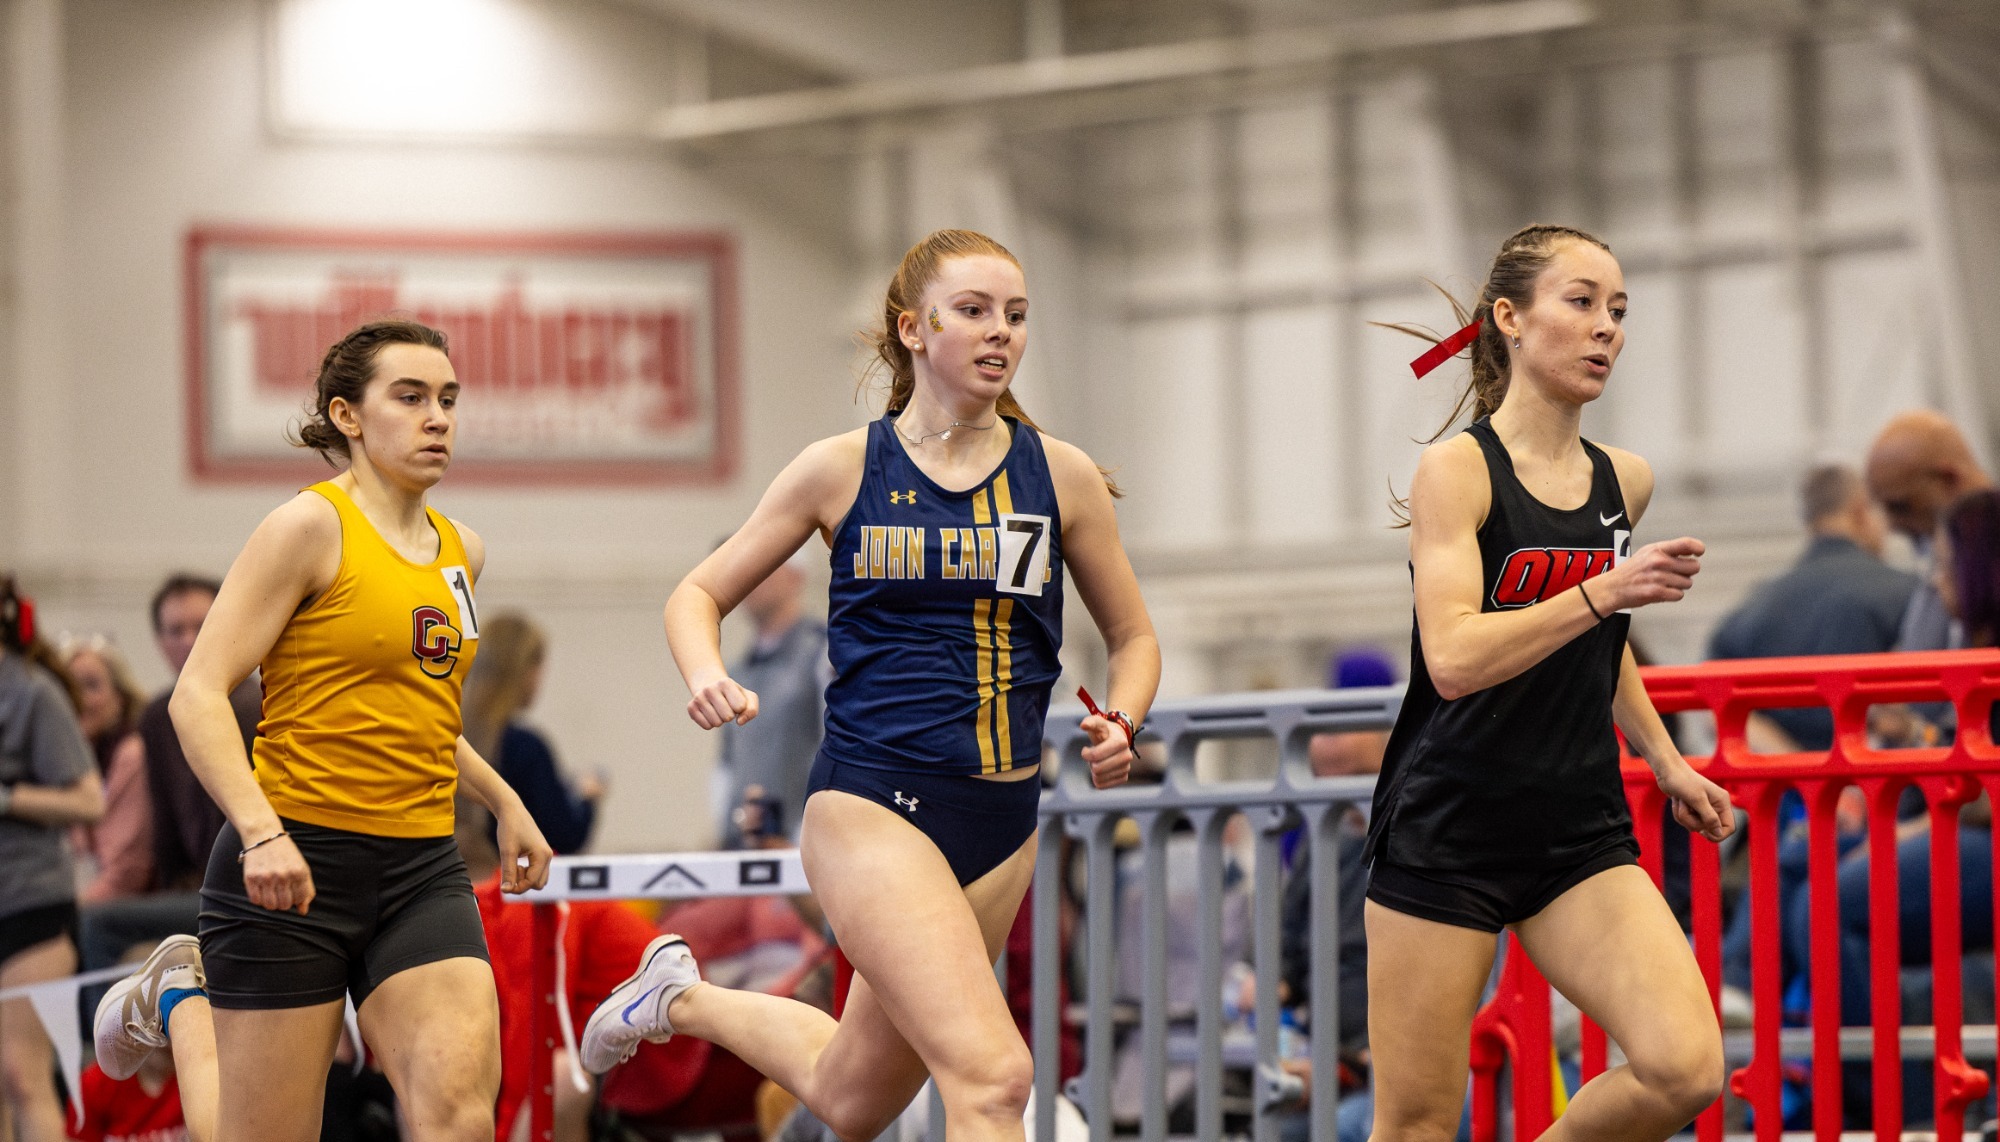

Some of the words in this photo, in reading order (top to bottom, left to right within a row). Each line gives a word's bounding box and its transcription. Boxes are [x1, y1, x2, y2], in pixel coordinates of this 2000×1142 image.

[854, 525, 925, 579] JOHN
[1007, 520, 1043, 588] 7
[1491, 547, 1614, 608] OW
[453, 571, 477, 634] 1
